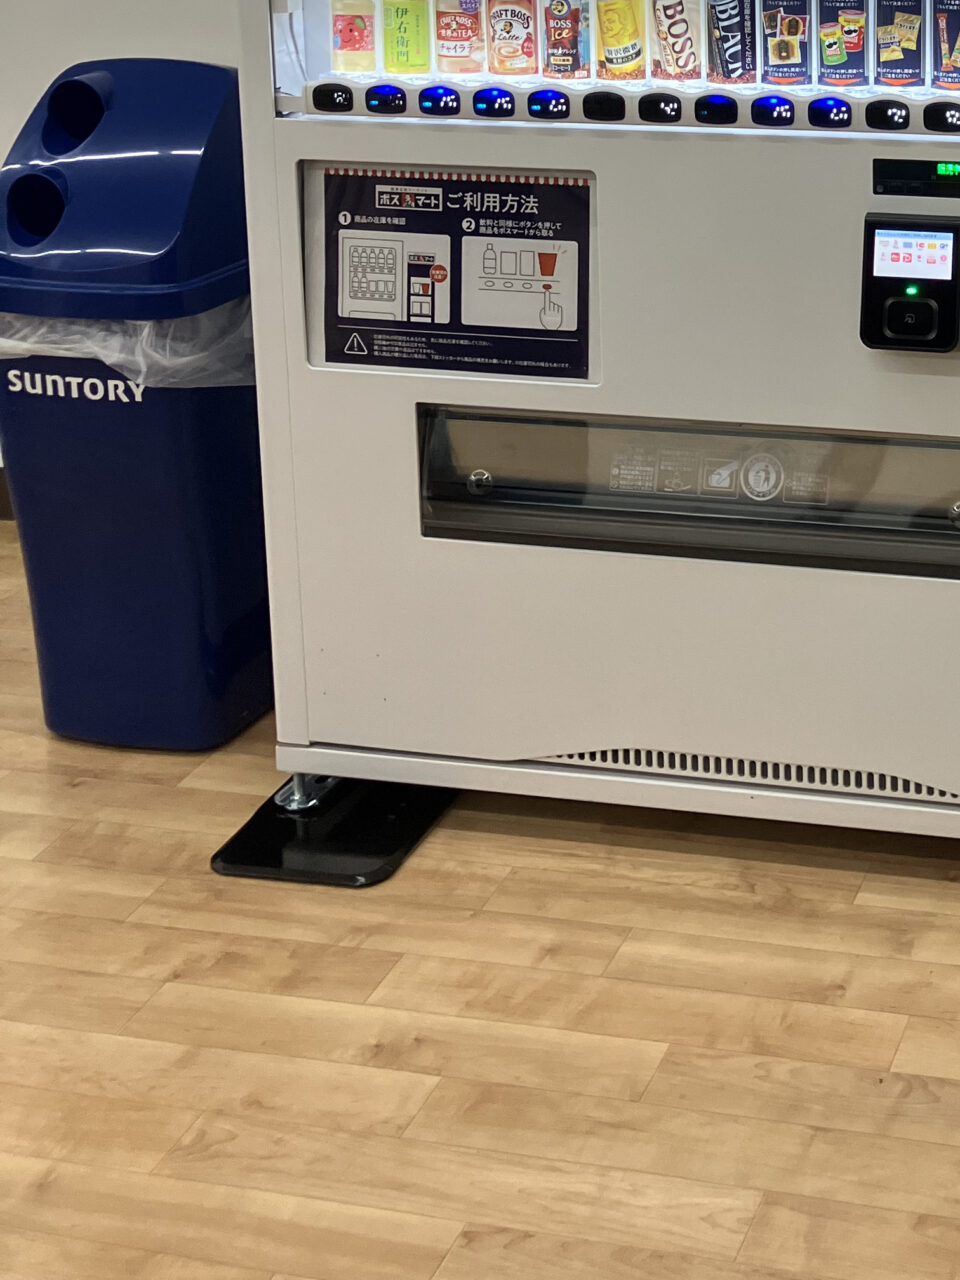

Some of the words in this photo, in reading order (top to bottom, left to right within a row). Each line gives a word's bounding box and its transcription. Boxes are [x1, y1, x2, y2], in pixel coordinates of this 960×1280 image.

[396, 7, 410, 62] 伊右衛門
[550, 20, 572, 28] BOSS
[446, 192, 540, 215] ご利用方法
[7, 369, 146, 403] SUNTORY
